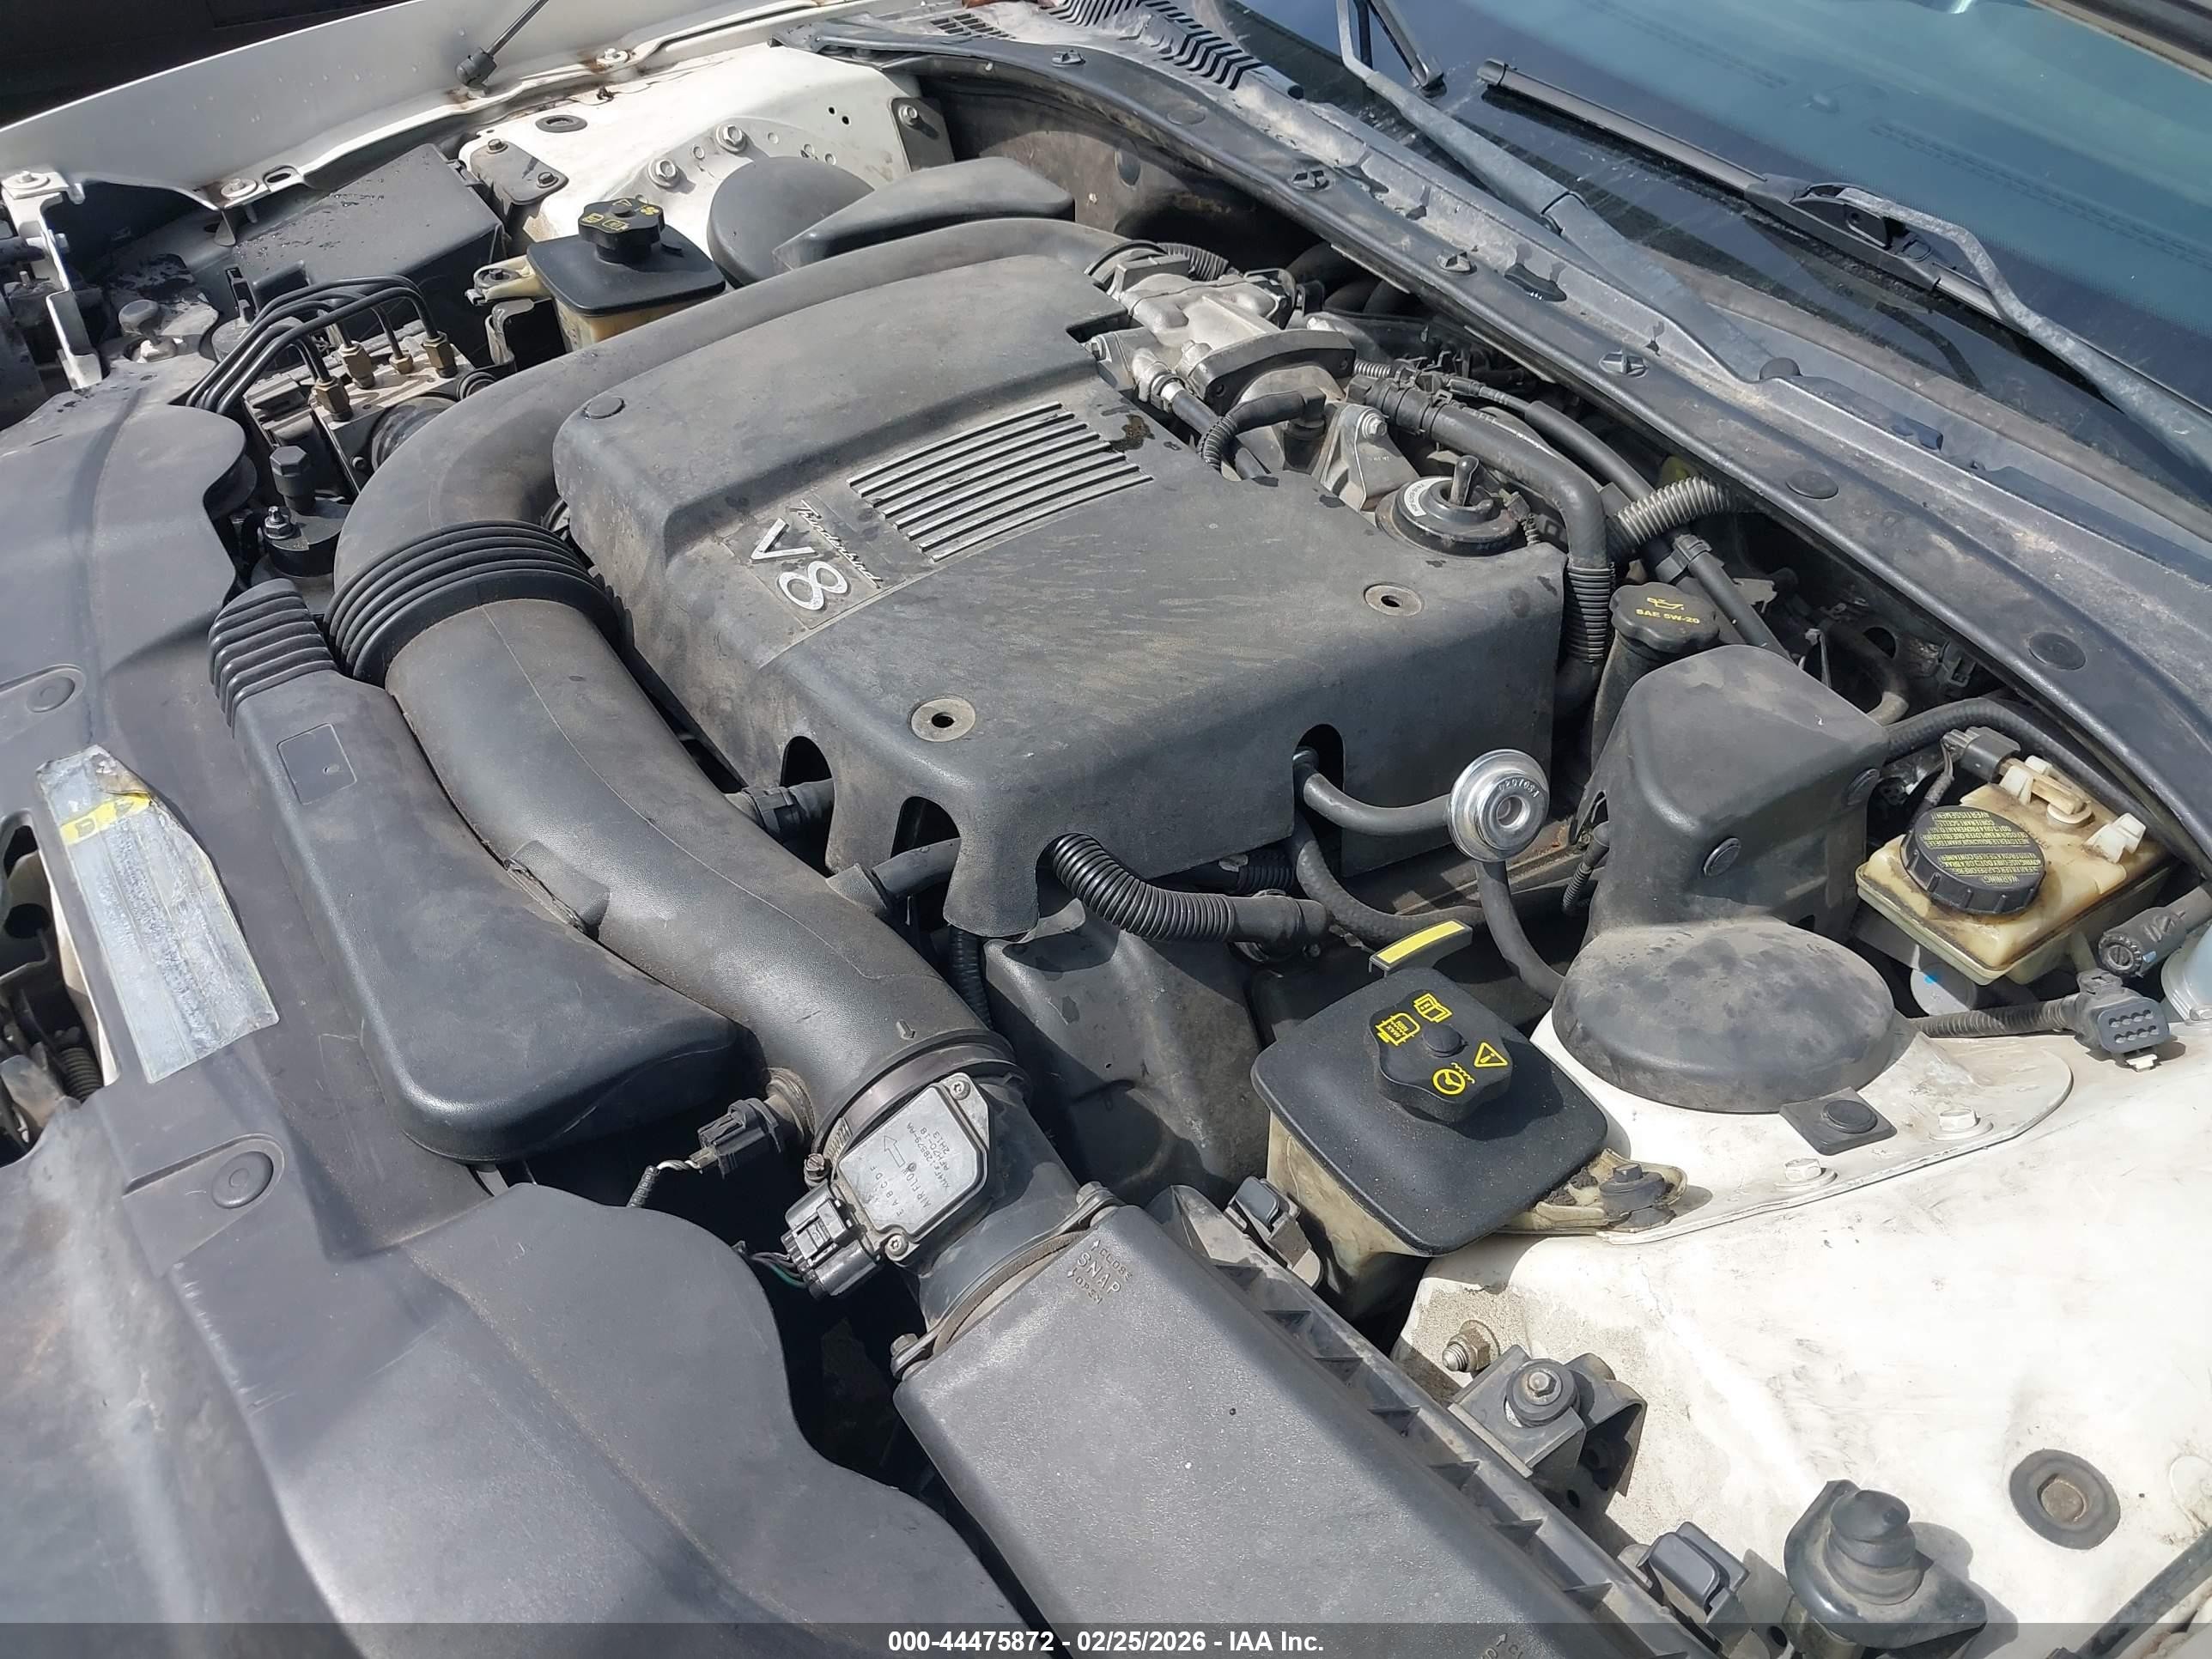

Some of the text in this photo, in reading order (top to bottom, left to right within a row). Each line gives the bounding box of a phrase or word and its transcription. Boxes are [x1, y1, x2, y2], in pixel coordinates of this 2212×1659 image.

[797, 499, 883, 589] Thunderbird
[750, 517, 848, 611] V8
[1635, 609, 1700, 623] SAE 5W-20
[933, 1131, 950, 1155] 2H13
[1077, 1252, 1121, 1294] SNAP
[1100, 1249, 1133, 1281] CLOSE
[1075, 1276, 1103, 1304] OPEN
